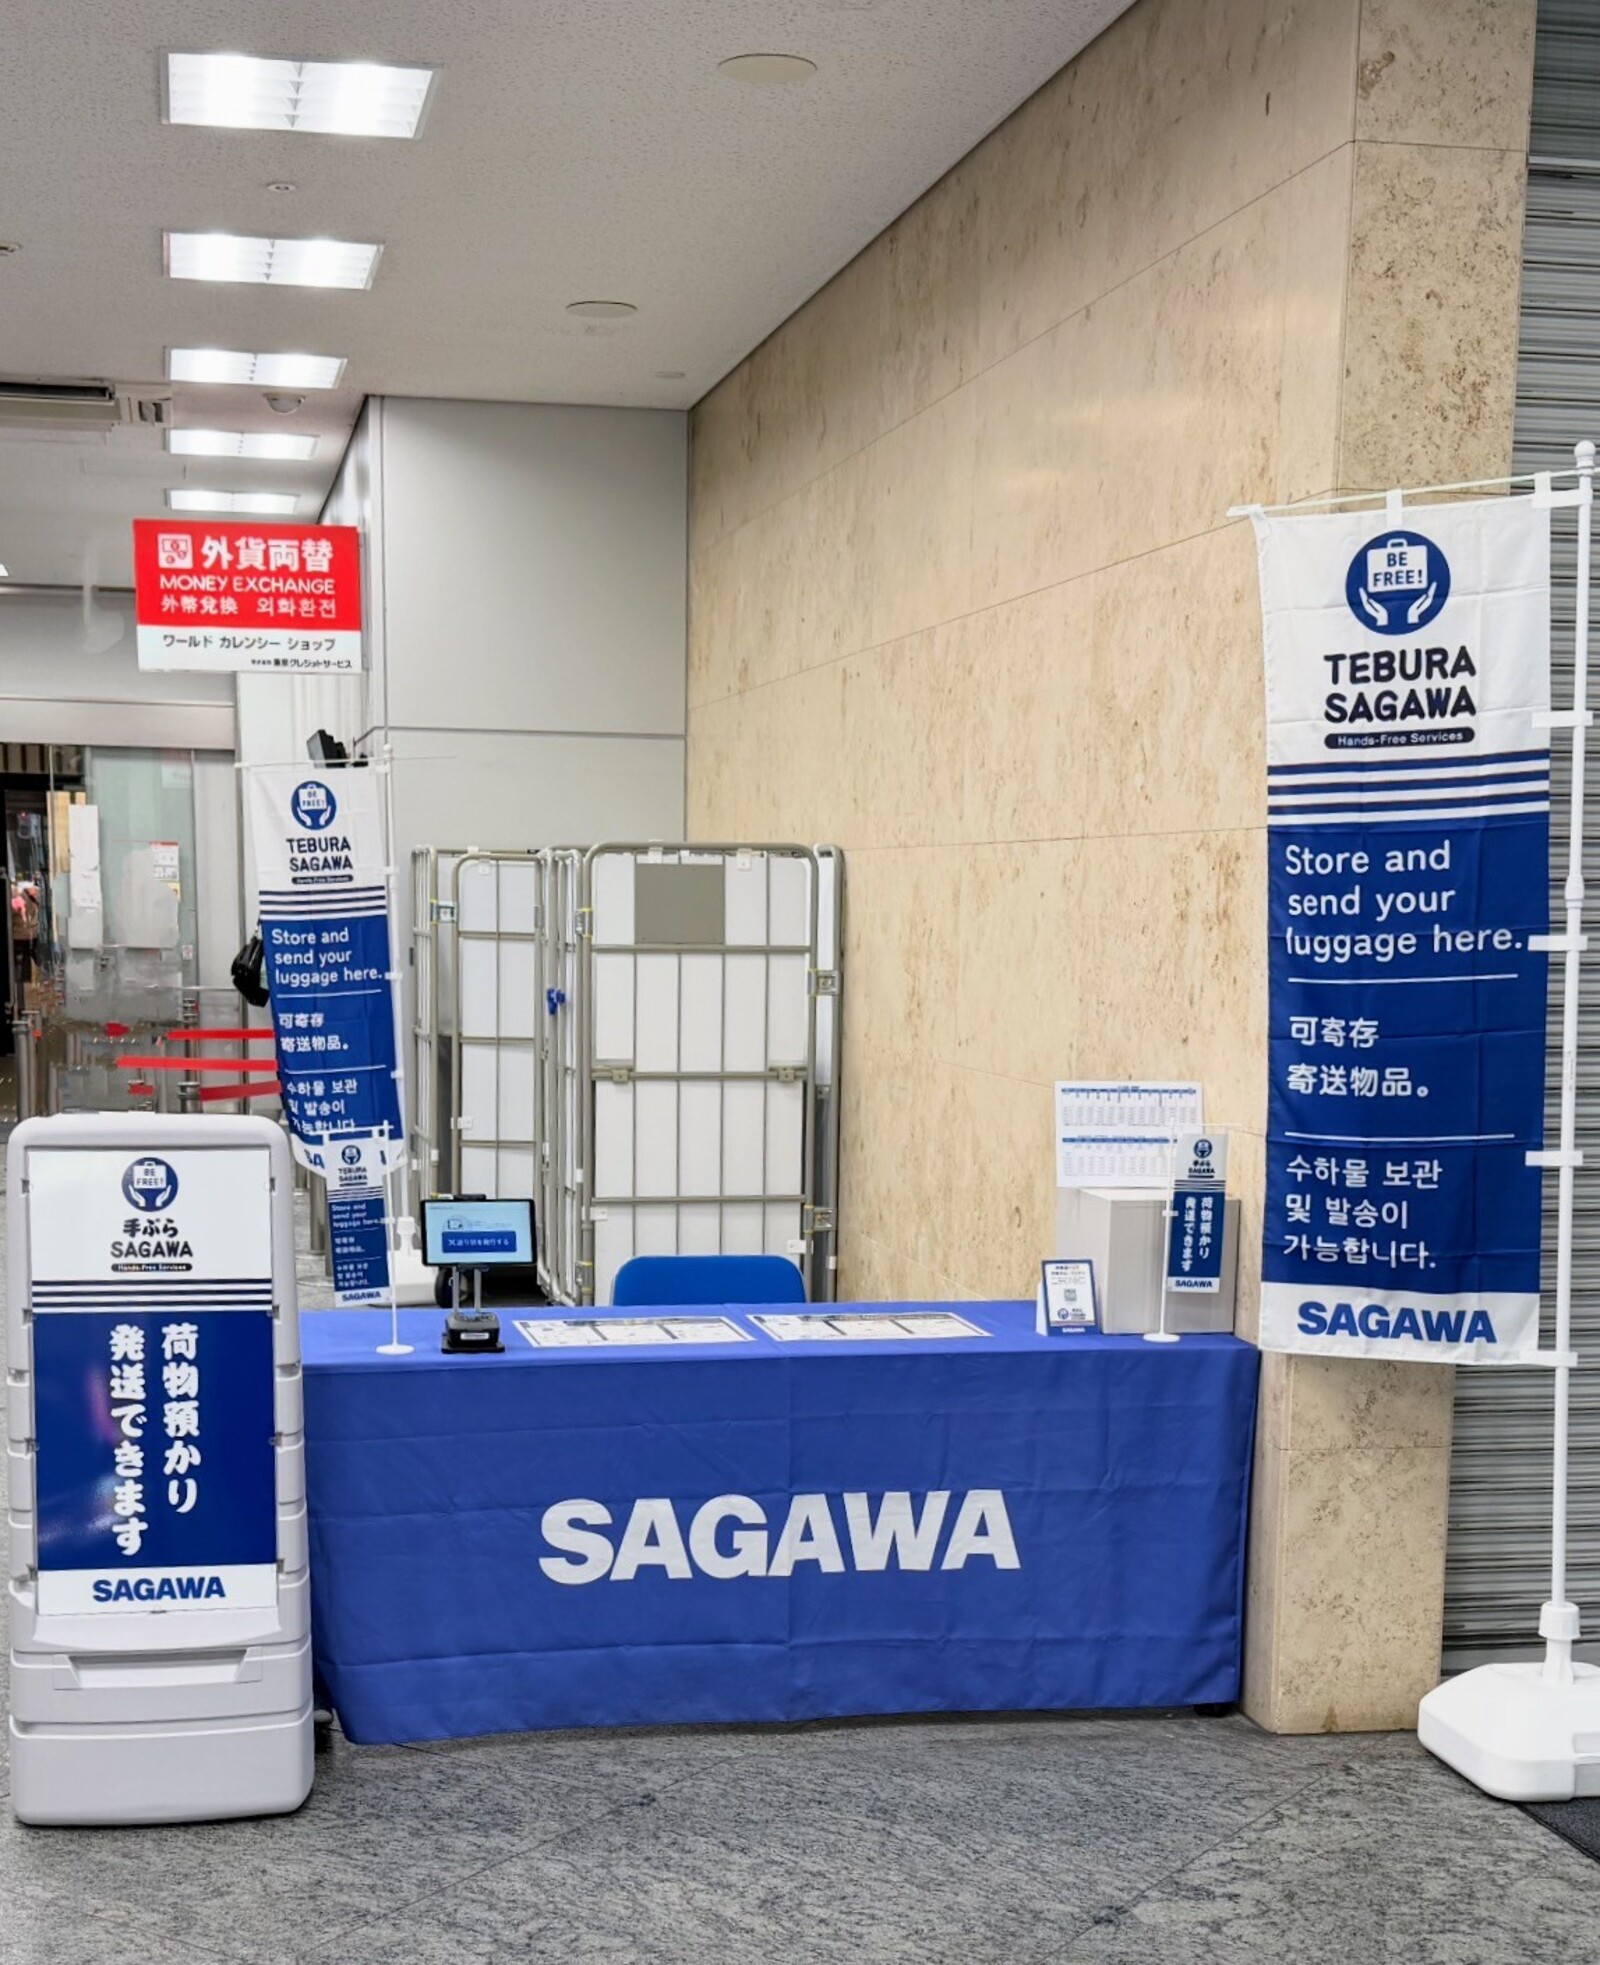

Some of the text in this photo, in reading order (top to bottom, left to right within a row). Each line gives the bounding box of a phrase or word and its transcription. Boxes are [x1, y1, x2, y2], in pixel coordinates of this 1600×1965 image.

[201, 535, 334, 573] 外貨両替
[1387, 552, 1407, 567] BE
[160, 574, 335, 594] MONEY EXCHANGE
[1373, 569, 1423, 586] FREE!
[256, 597, 336, 618] 외화환전
[163, 634, 336, 651] ワールド カレンシー ショップ
[1324, 645, 1476, 685] TEBURA
[1324, 686, 1476, 723] SAGAWA
[1337, 731, 1463, 747] Hands-Free Services
[286, 836, 352, 854] TEBURA
[289, 855, 353, 872] SAGAWA
[1285, 839, 1451, 875] Store and
[1288, 885, 1457, 922] send your
[271, 927, 349, 945] Store and
[1285, 924, 1523, 963] luggage here.
[274, 949, 352, 968] send your
[275, 967, 383, 988] luggage here.
[1289, 1016, 1379, 1048] 可寄存
[331, 1078, 357, 1094] 보관
[1287, 1063, 1429, 1098] 寄送物品。
[304, 1099, 345, 1117] 발송이
[1286, 1154, 1443, 1189] 수하물 보관
[1285, 1193, 1408, 1230] 및 발송이
[122, 1218, 178, 1238] 手ぶら
[110, 1240, 193, 1258] SAGAWA
[1283, 1234, 1436, 1270] 가능합니다.
[1175, 1278, 1213, 1288] SAGAWA
[341, 1290, 382, 1302] SAGAWA
[1297, 1301, 1497, 1344] SAGAWA
[162, 1322, 202, 1513] 荷物預かり
[109, 1324, 149, 1556] 発送できます
[538, 1489, 1021, 1585] SAGAWA
[93, 1576, 225, 1602] SAGAWA
